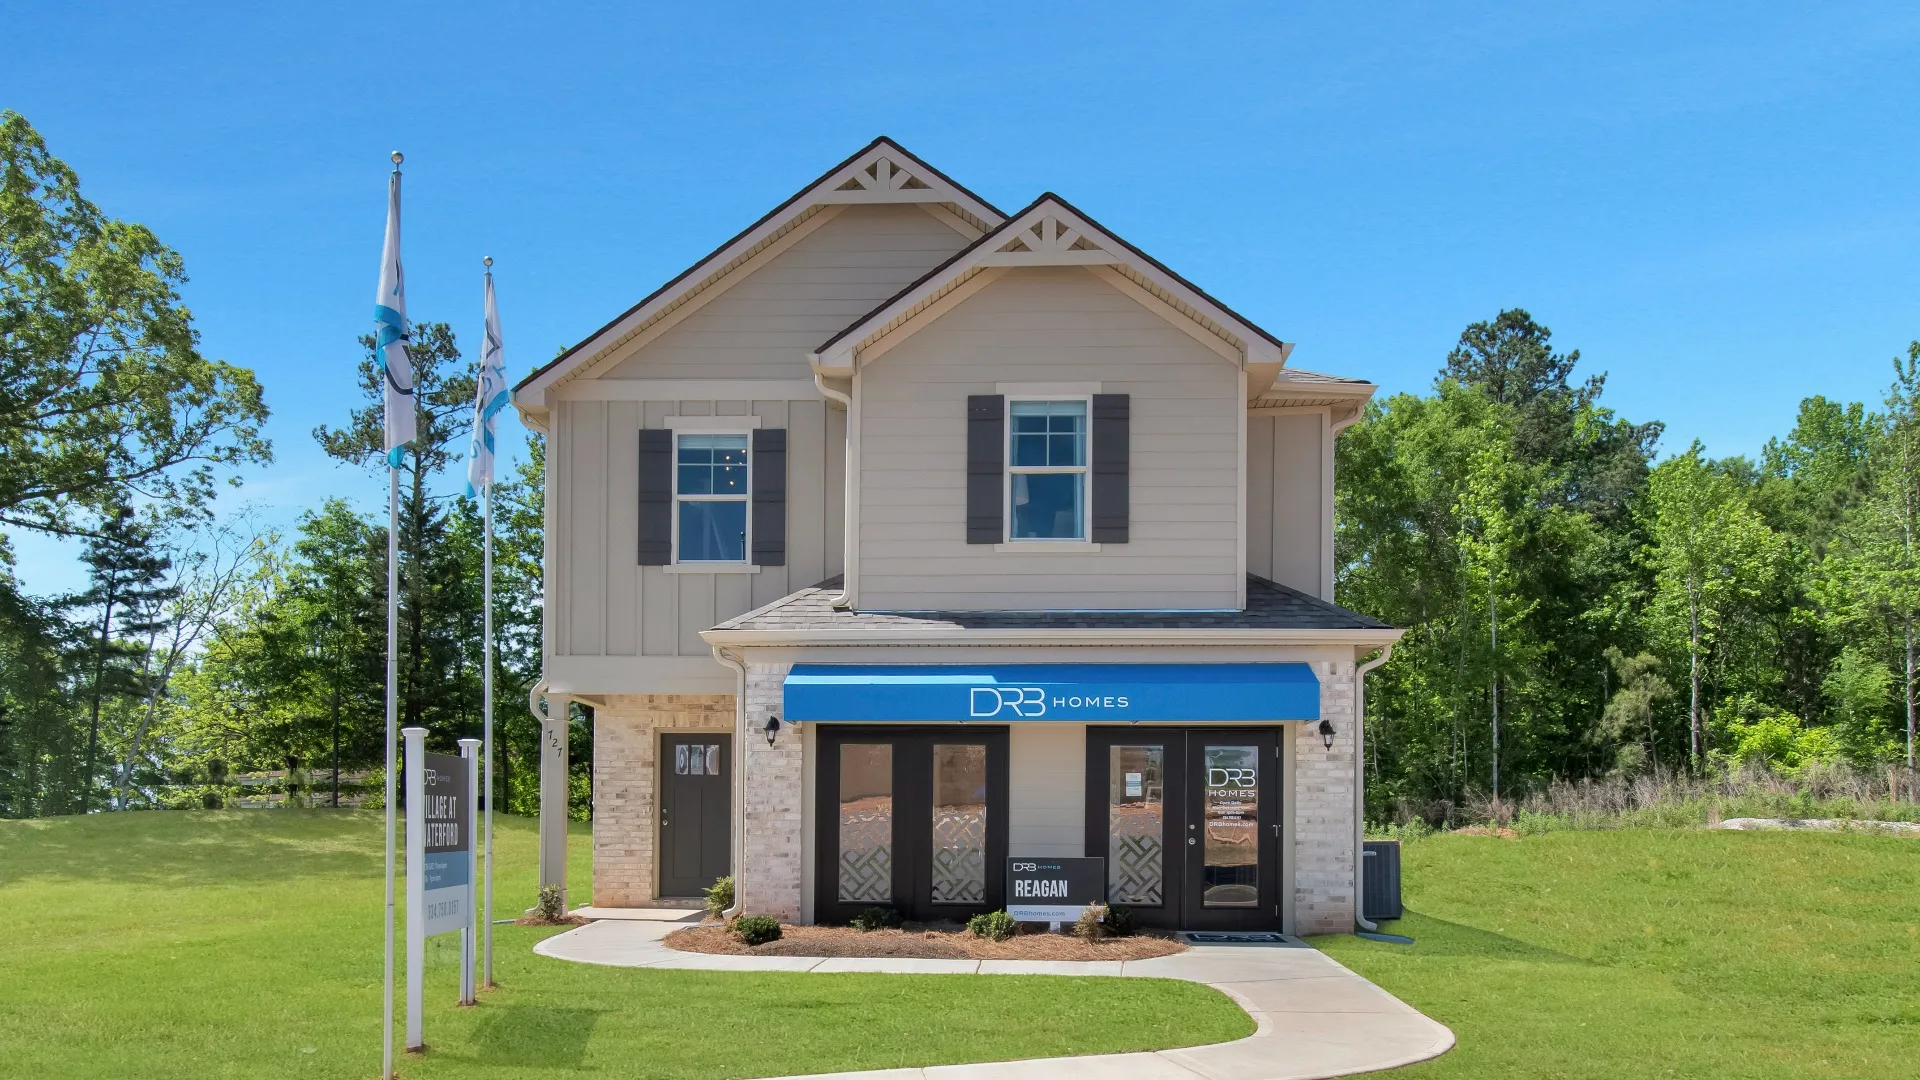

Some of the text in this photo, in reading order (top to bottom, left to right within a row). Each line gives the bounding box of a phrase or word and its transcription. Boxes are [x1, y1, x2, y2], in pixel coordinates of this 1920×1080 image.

[969, 687, 1130, 717] DRB HOMES
[1208, 768, 1256, 787] DRB
[1208, 789, 1255, 797] HOMES
[424, 794, 457, 819] ILLAGE AT
[1013, 862, 1037, 872] DRB
[1015, 879, 1068, 898] REAGAN
